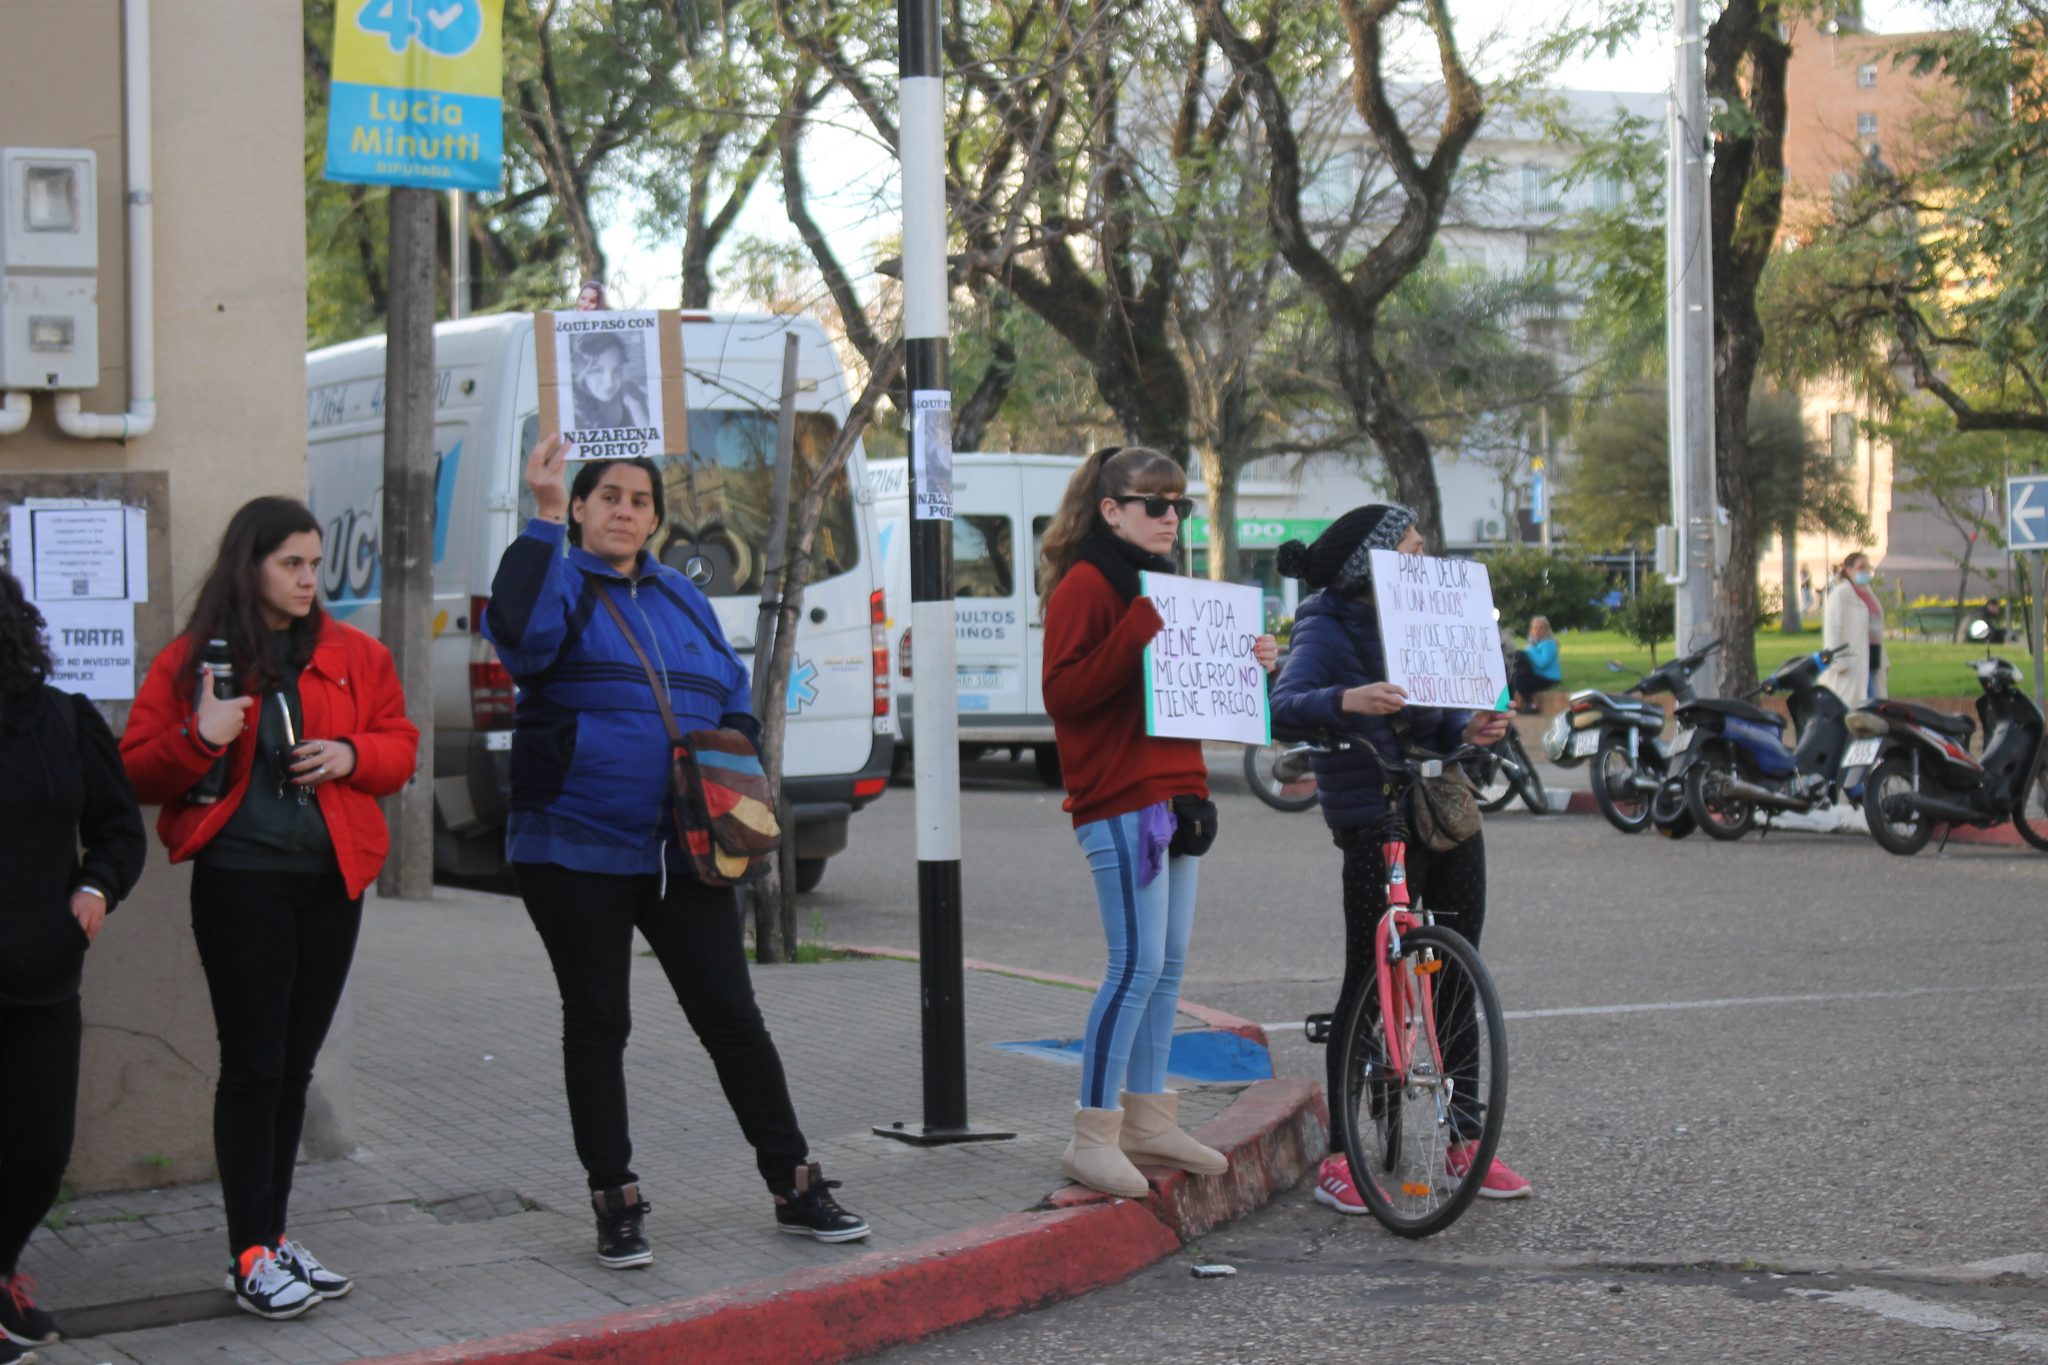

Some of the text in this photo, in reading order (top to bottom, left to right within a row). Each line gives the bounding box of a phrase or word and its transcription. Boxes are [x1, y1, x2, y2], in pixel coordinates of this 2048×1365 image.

[369, 91, 463, 126] Lucía
[350, 125, 480, 161] Minutti
[375, 161, 453, 178] DIPUTADA
[556, 316, 655, 332] ¿QUÉ PASÓ CON
[563, 427, 660, 444] NAZARENA
[579, 441, 648, 458] PORTO?
[1399, 552, 1472, 588] PARA DECIR
[1155, 594, 1237, 630] MI VIDA
[61, 628, 125, 646] TRATA
[1155, 626, 1258, 661] TIENE VALOR
[1405, 623, 1422, 648] HAY
[1424, 623, 1444, 647] QUE
[1155, 659, 1259, 691] MI CUERPO NO
[1408, 675, 1437, 703] ACOSO
[1154, 688, 1205, 718] TIENE
